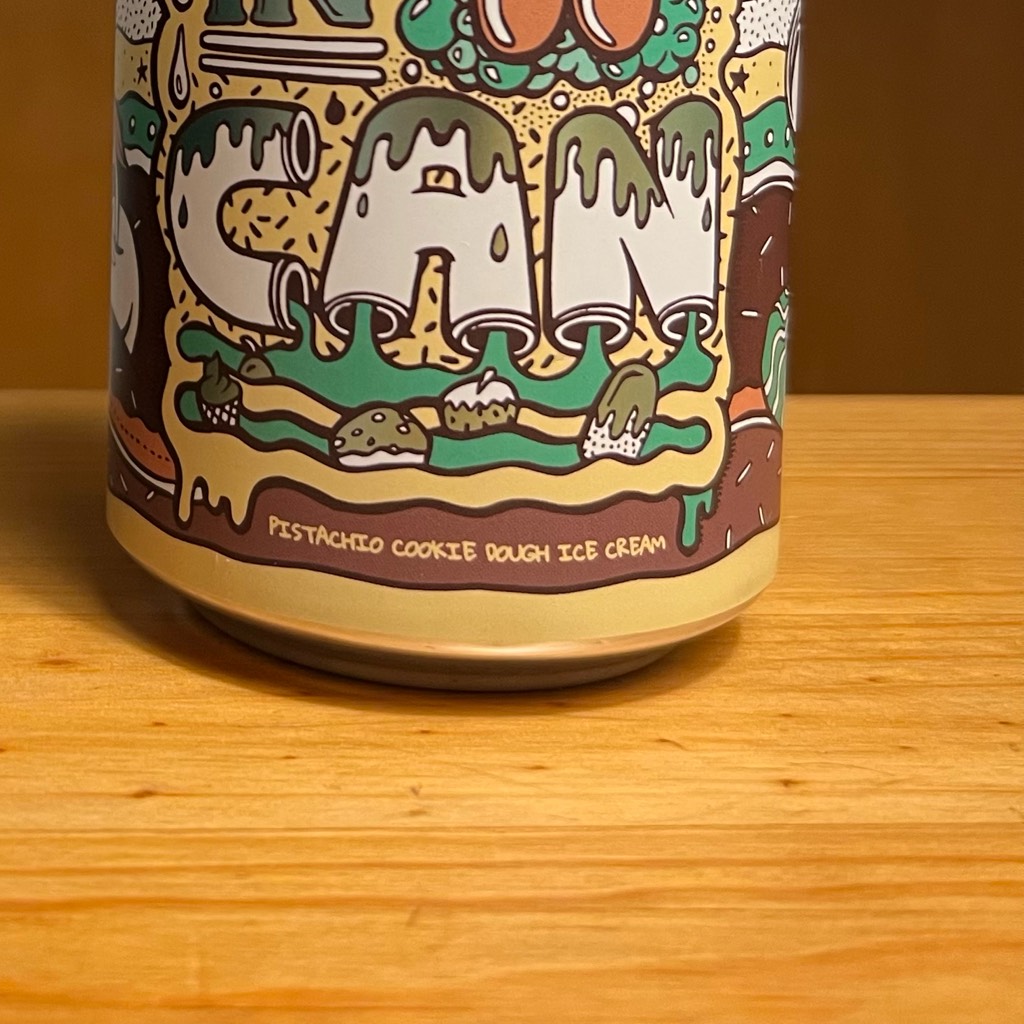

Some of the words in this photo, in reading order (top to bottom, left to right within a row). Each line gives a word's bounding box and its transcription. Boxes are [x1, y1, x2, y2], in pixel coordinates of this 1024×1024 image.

[169, 93, 721, 355] CAN
[268, 515, 385, 555] PISTACHIO
[391, 538, 477, 562] COOKIE
[486, 542, 551, 563] DOUGH
[558, 540, 598, 562] ICE
[605, 535, 667, 559] CREAM
